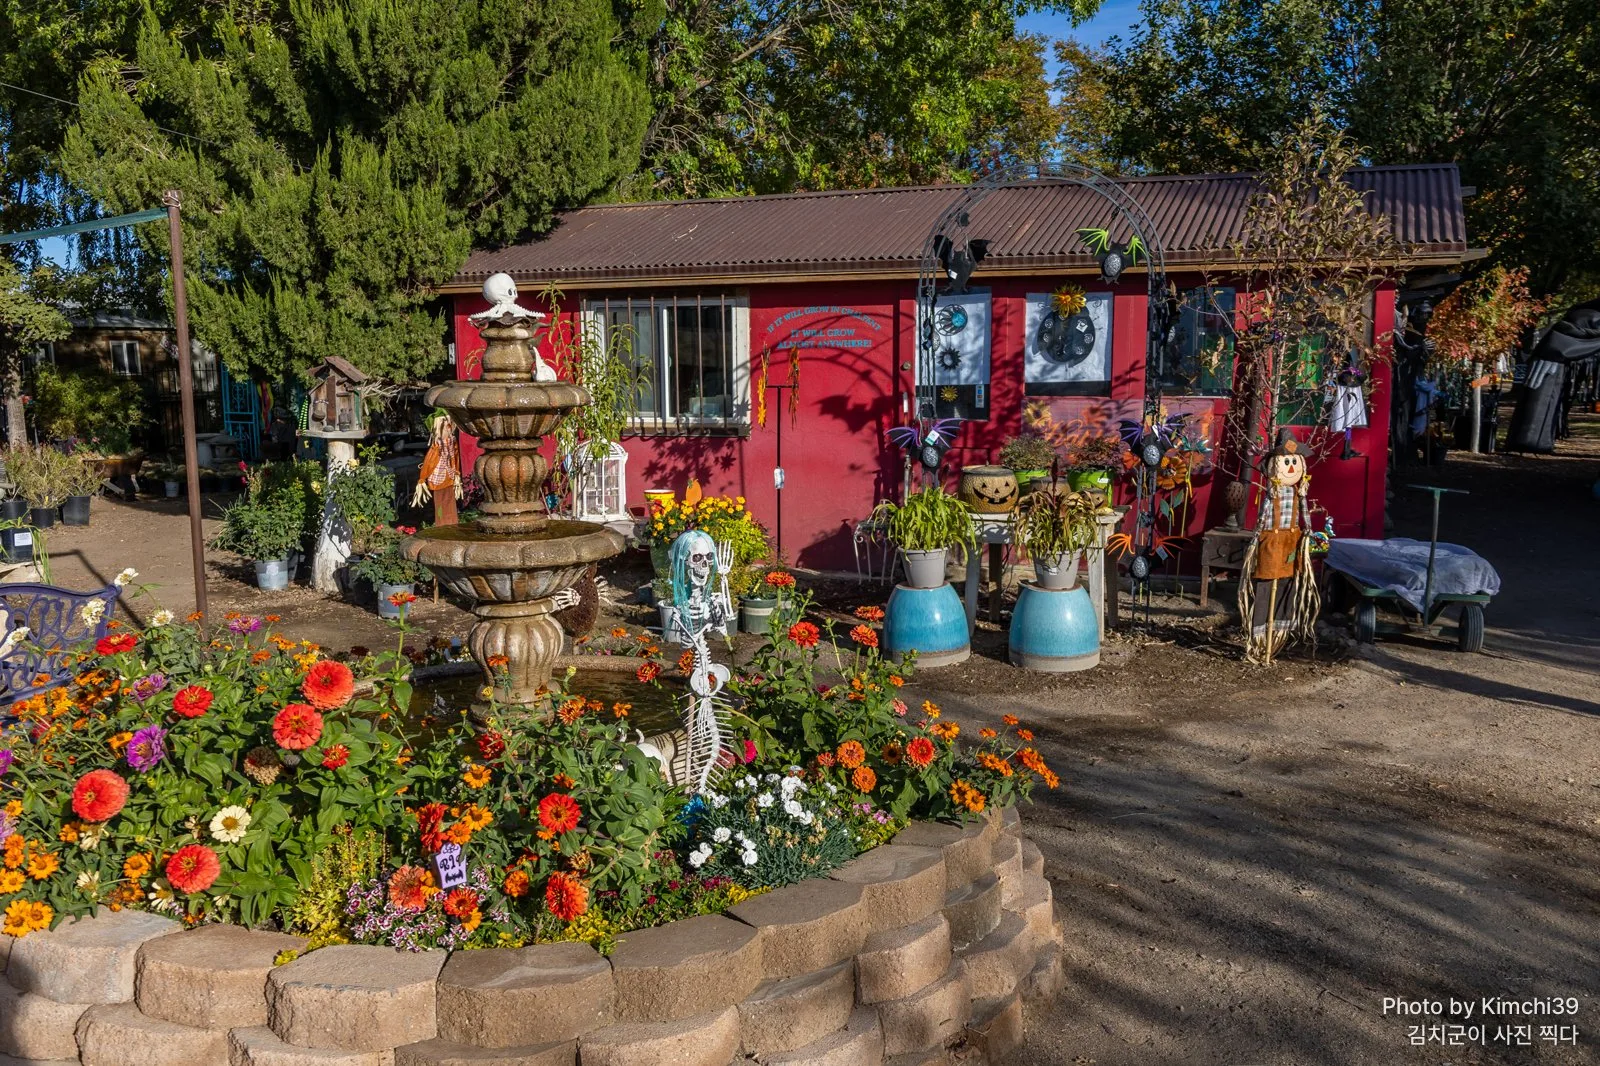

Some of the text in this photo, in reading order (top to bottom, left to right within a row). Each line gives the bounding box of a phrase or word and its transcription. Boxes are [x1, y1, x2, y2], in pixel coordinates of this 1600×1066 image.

[783, 309, 804, 321] WILL
[804, 306, 829, 315] GROW
[830, 305, 840, 313] IN
[791, 328, 855, 338] IT WILL GROW
[777, 340, 816, 349] ALMOST
